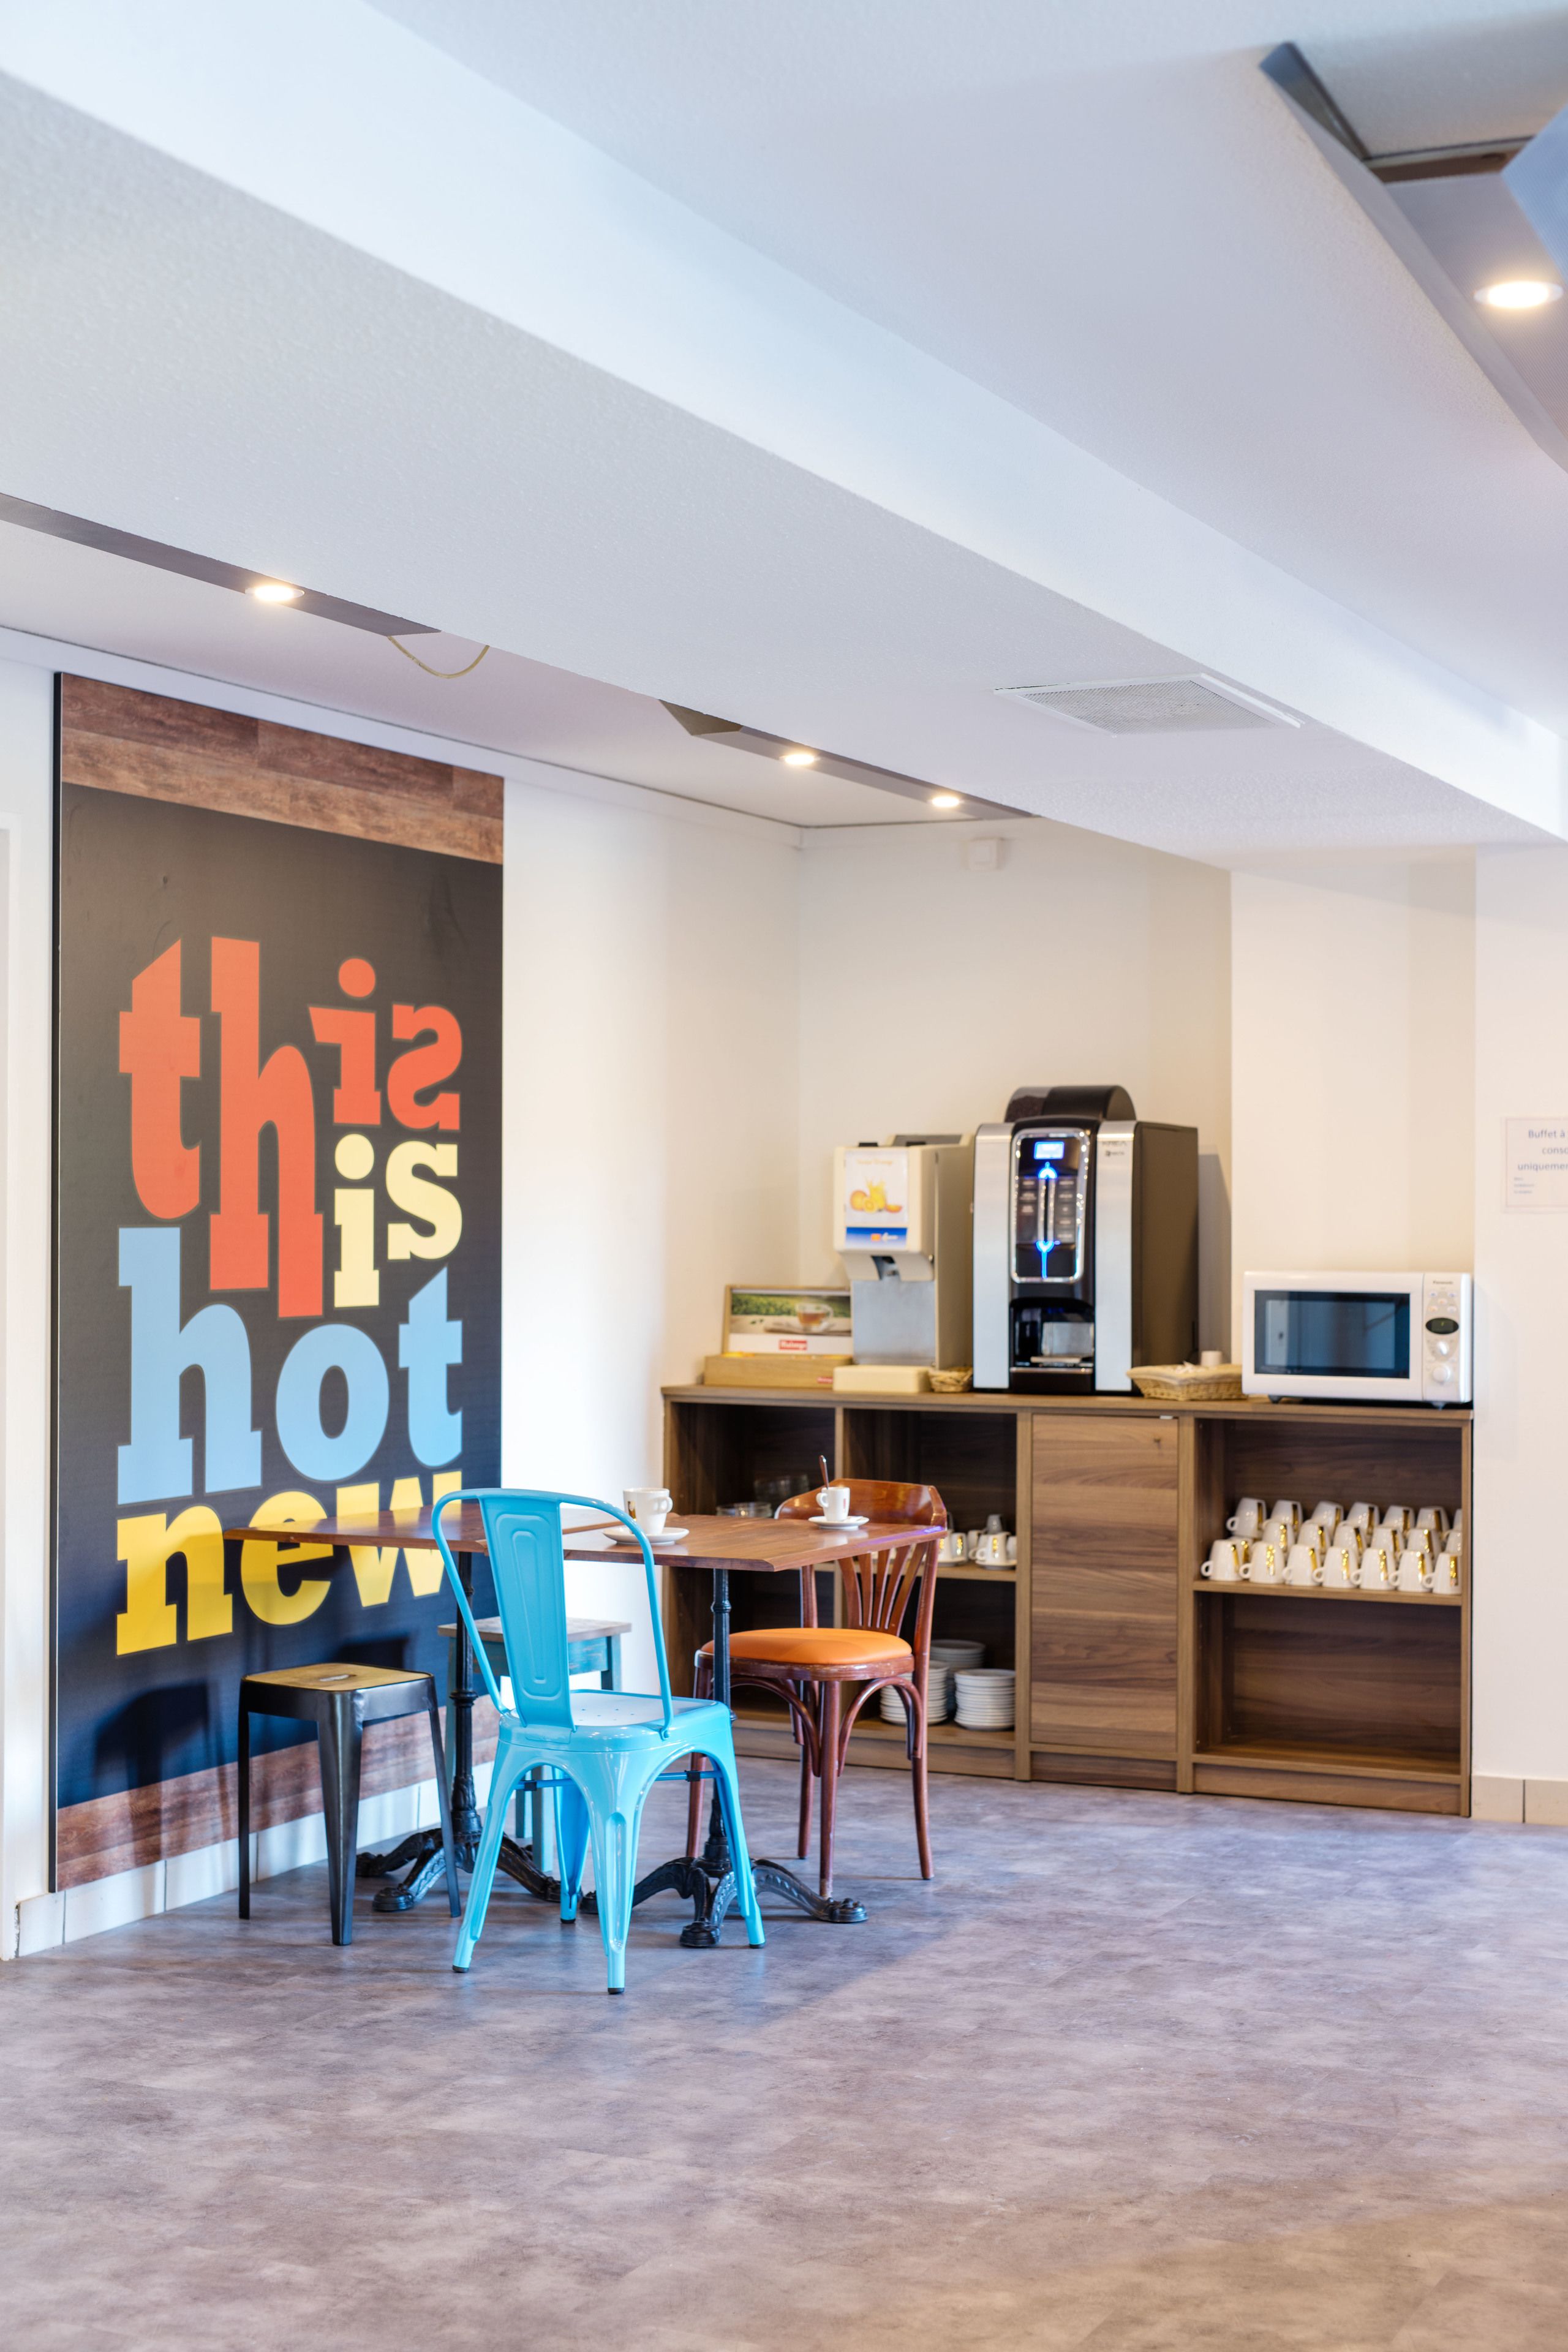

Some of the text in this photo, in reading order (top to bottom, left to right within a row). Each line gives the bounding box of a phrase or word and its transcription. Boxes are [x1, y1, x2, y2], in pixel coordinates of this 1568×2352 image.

[118, 936, 463, 1319] this
[333, 1133, 463, 1307] is
[1528, 1129, 1566, 1138] Buffet à
[117, 1226, 463, 1505] hot
[116, 1470, 463, 1656] new
